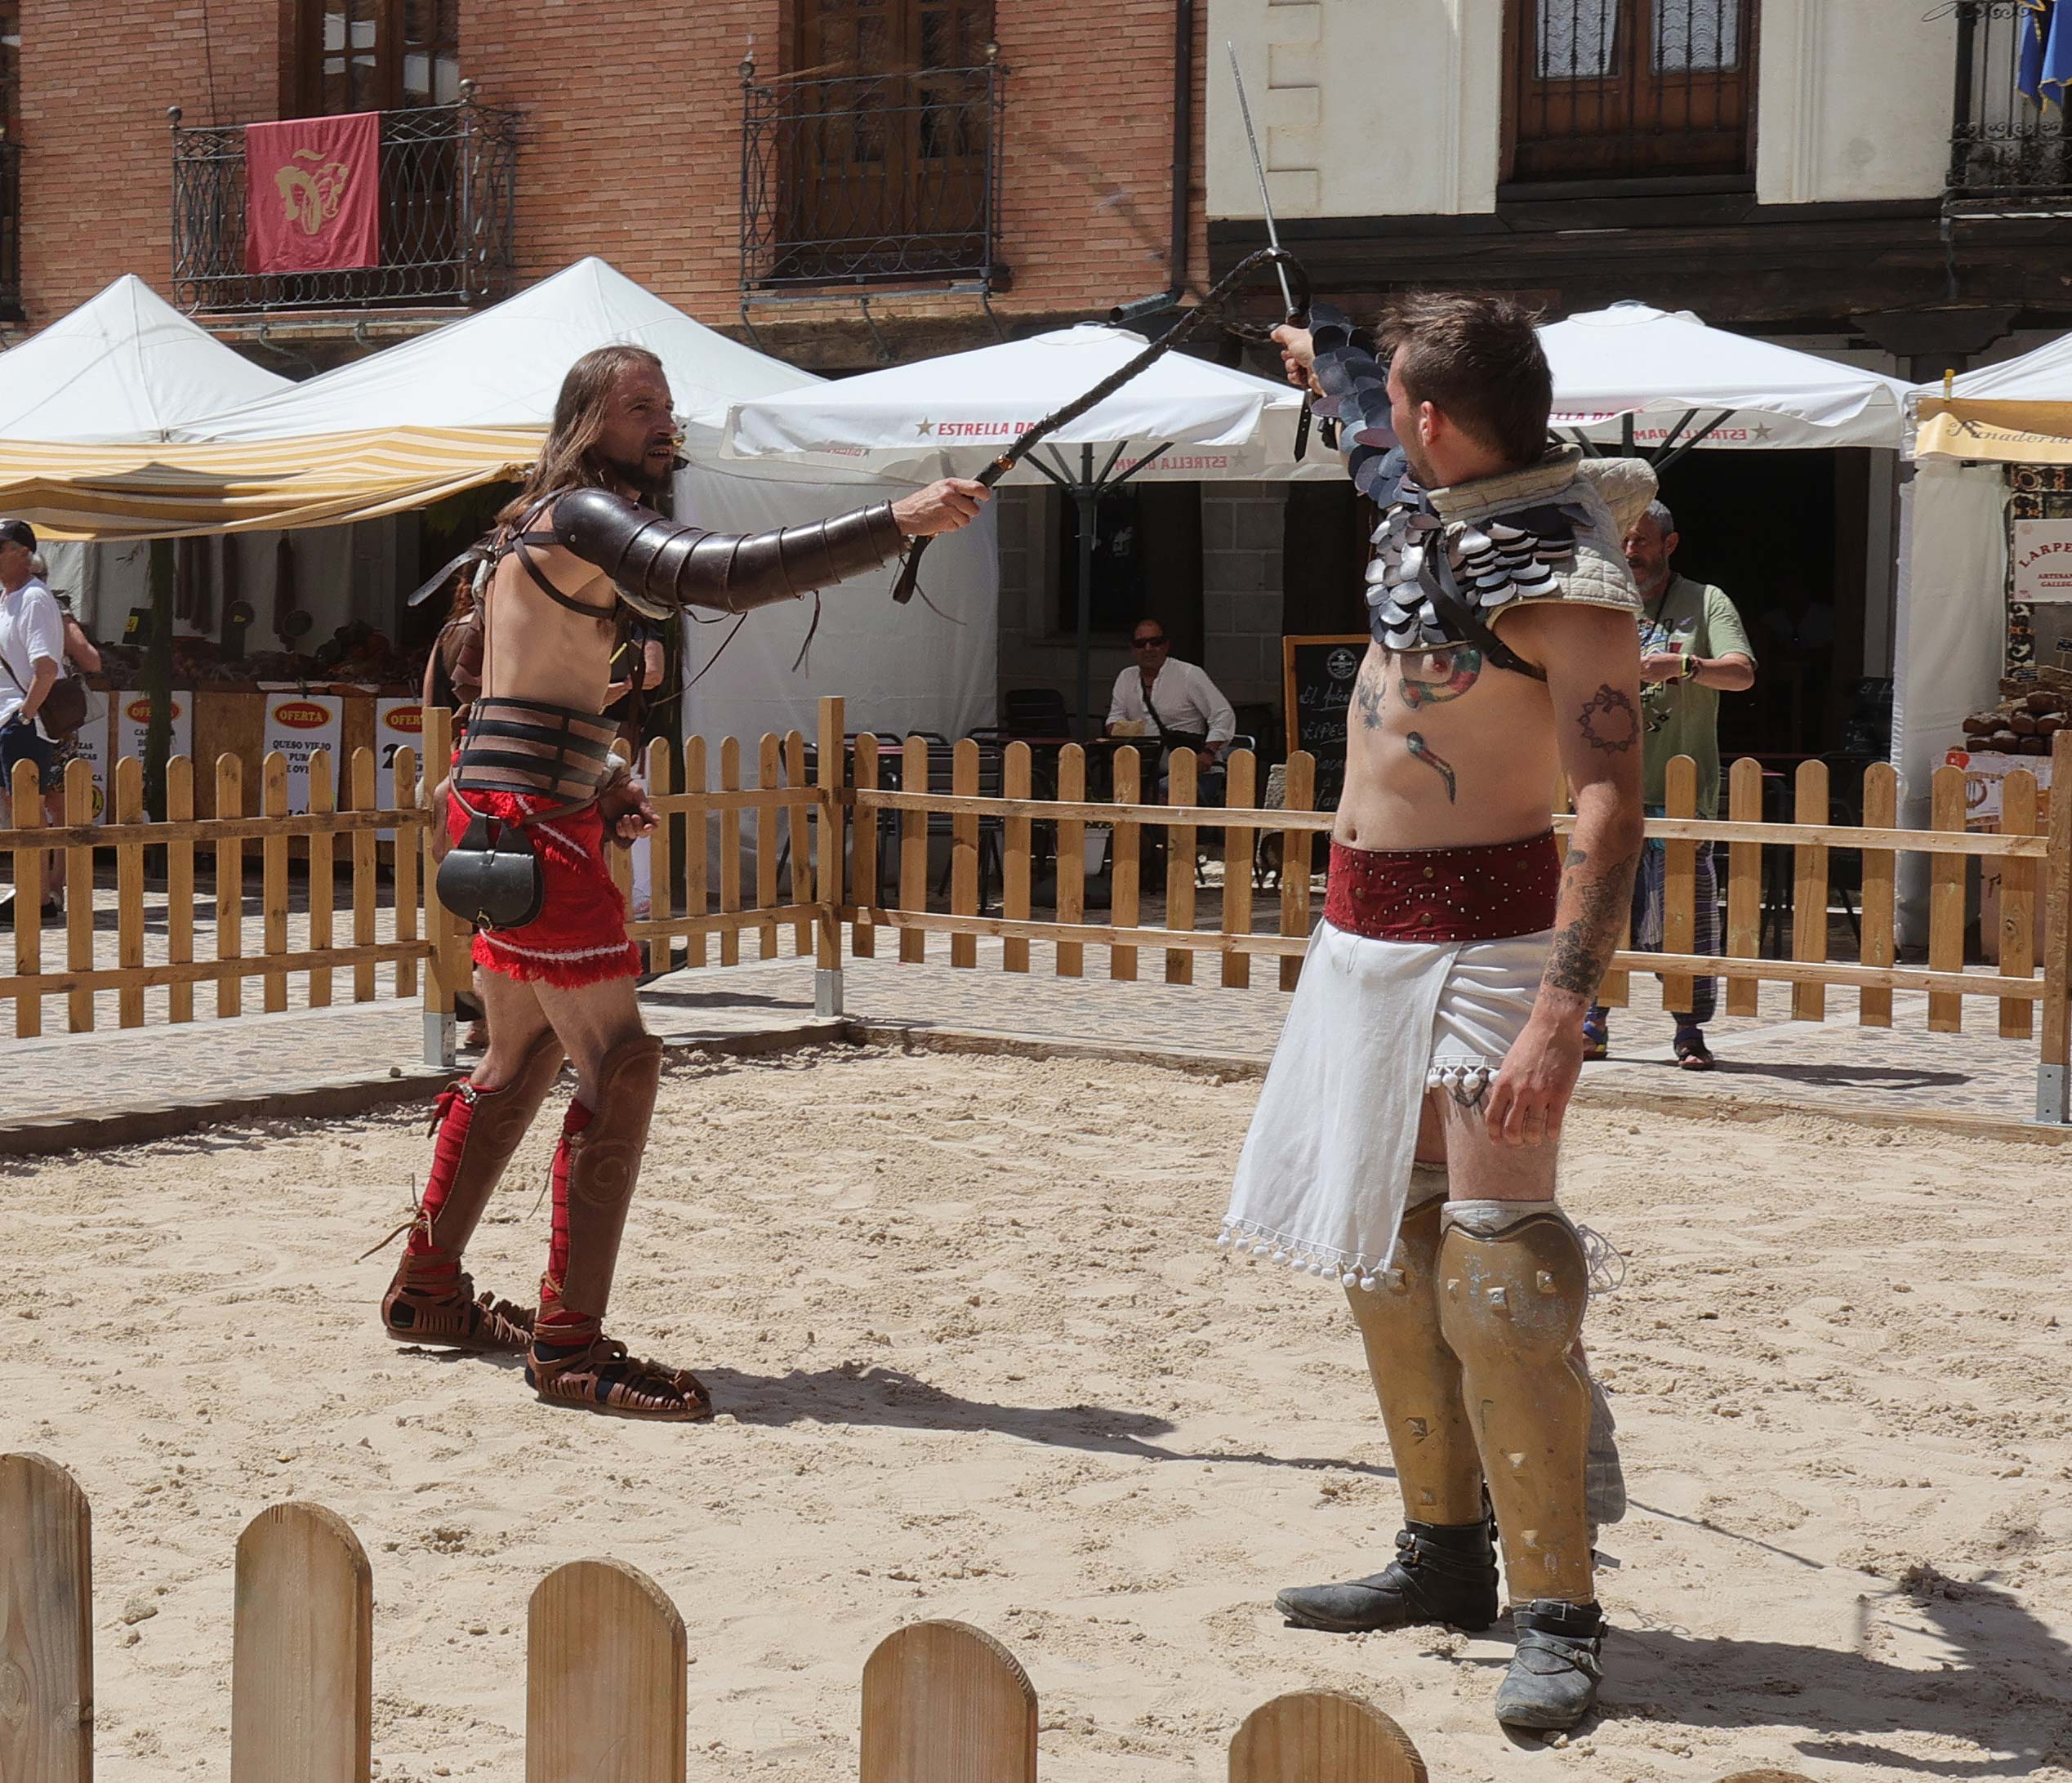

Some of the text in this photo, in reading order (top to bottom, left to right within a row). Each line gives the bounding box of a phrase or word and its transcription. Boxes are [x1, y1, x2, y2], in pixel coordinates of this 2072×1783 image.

[938, 422, 1009, 436] ESTRELLA
[279, 710, 323, 722] OFERTA
[390, 714, 422, 725] OFER
[273, 739, 332, 751] QUESO VIEJO
[292, 764, 310, 774] OVE
